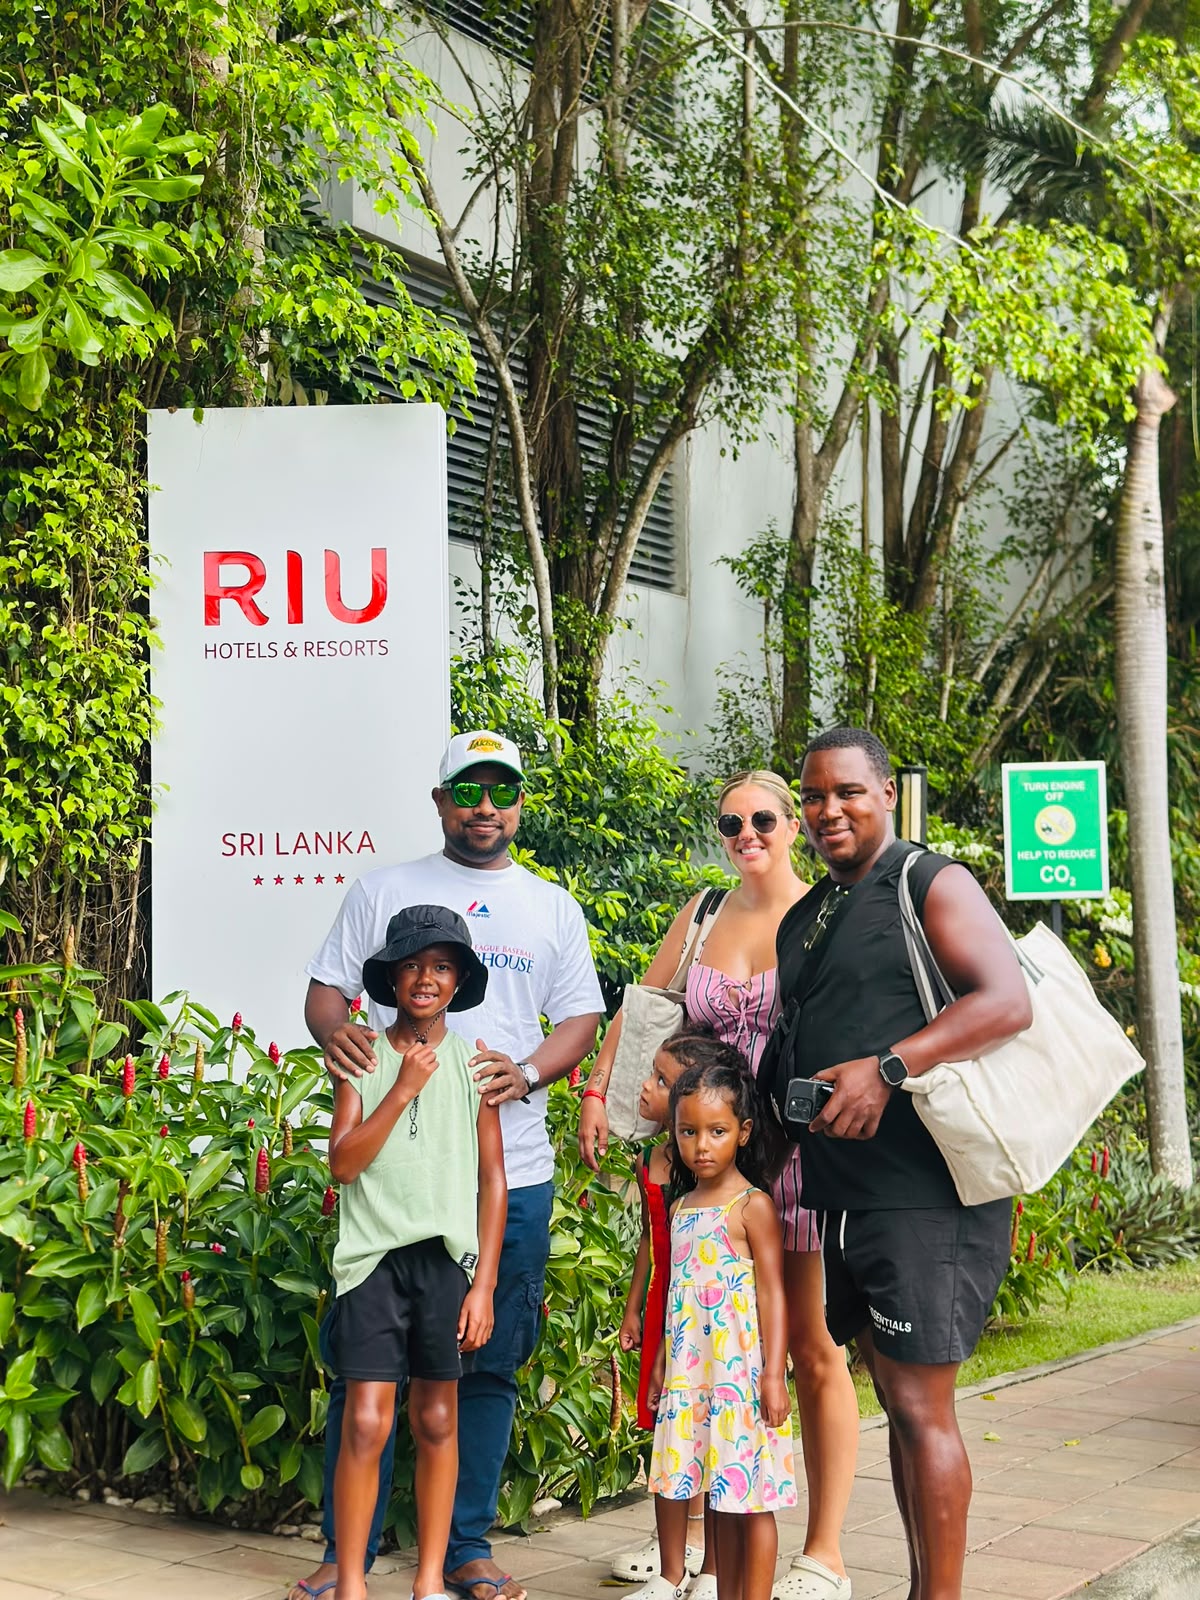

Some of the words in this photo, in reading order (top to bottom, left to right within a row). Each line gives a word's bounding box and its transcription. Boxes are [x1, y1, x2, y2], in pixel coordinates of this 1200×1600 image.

[203, 547, 388, 627] RIU
[204, 641, 278, 660] HOTELS
[283, 641, 298, 658] &
[304, 639, 389, 657] RESORTS
[1023, 782, 1048, 792] TURN
[1050, 781, 1085, 791] ENGINE
[1045, 792, 1064, 802] OFF
[221, 832, 264, 857] SRI
[275, 830, 376, 855] LANKA
[1017, 850, 1042, 860] HELP
[1044, 850, 1056, 859] TO
[1058, 849, 1097, 859] REDUCE
[474, 944, 500, 952] EAGUE
